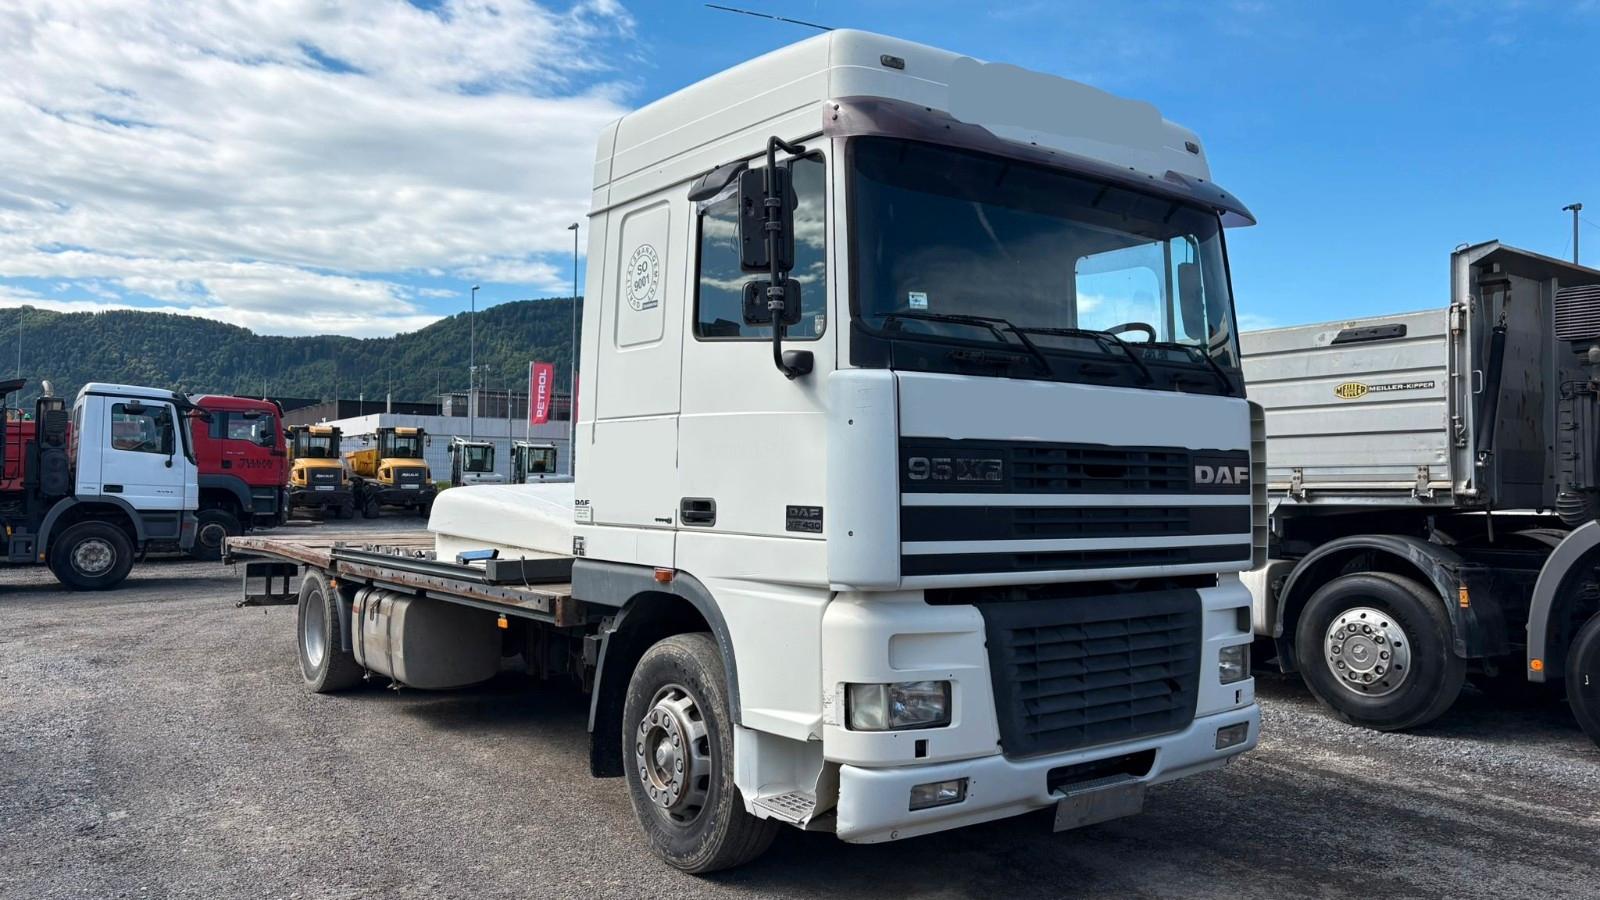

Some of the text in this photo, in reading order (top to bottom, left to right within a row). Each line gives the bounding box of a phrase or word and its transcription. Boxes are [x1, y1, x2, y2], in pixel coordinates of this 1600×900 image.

[634, 273, 650, 292] 9001
[536, 369, 547, 418] PETROL
[1336, 382, 1434, 397] MEILLER MEILLER-KIPPER
[1194, 465, 1249, 484] DAF
[789, 508, 820, 517] DAF
